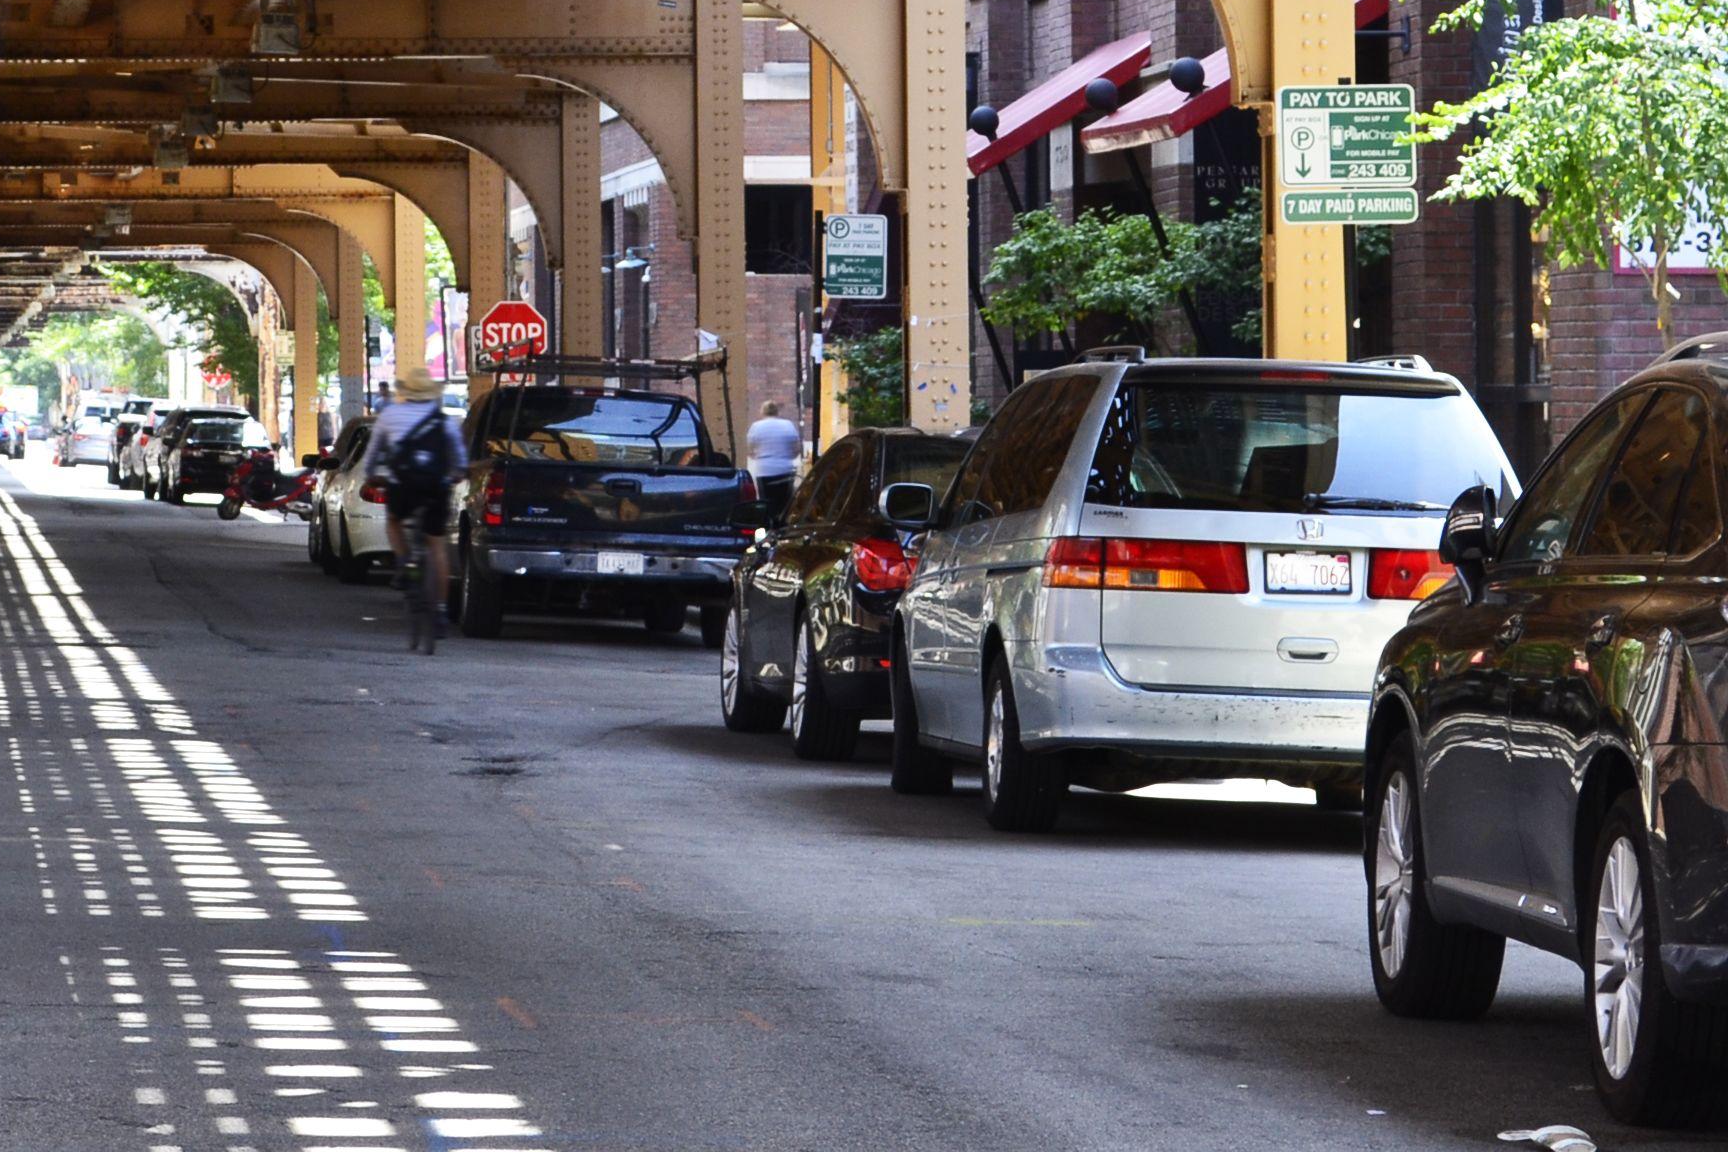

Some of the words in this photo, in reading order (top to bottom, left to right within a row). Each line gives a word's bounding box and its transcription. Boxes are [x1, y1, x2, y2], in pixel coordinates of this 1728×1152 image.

[1289, 92, 1322, 107] PAY
[1325, 91, 1351, 106] TO
[1354, 91, 1402, 106] PARK
[1353, 115, 1370, 123] SIGN
[1371, 115, 1381, 123] UP
[1297, 131, 1309, 146] P
[1348, 164, 1376, 177] 243
[1379, 164, 1406, 177] 409
[1287, 200, 1294, 214] 7
[1299, 200, 1323, 214] DAY
[1325, 199, 1355, 213] PAID
[1358, 198, 1413, 213] PARKING
[835, 222, 845, 235] P
[842, 287, 859, 295] 243
[485, 322, 542, 347] STOP
[1310, 564, 1349, 587] 7062
